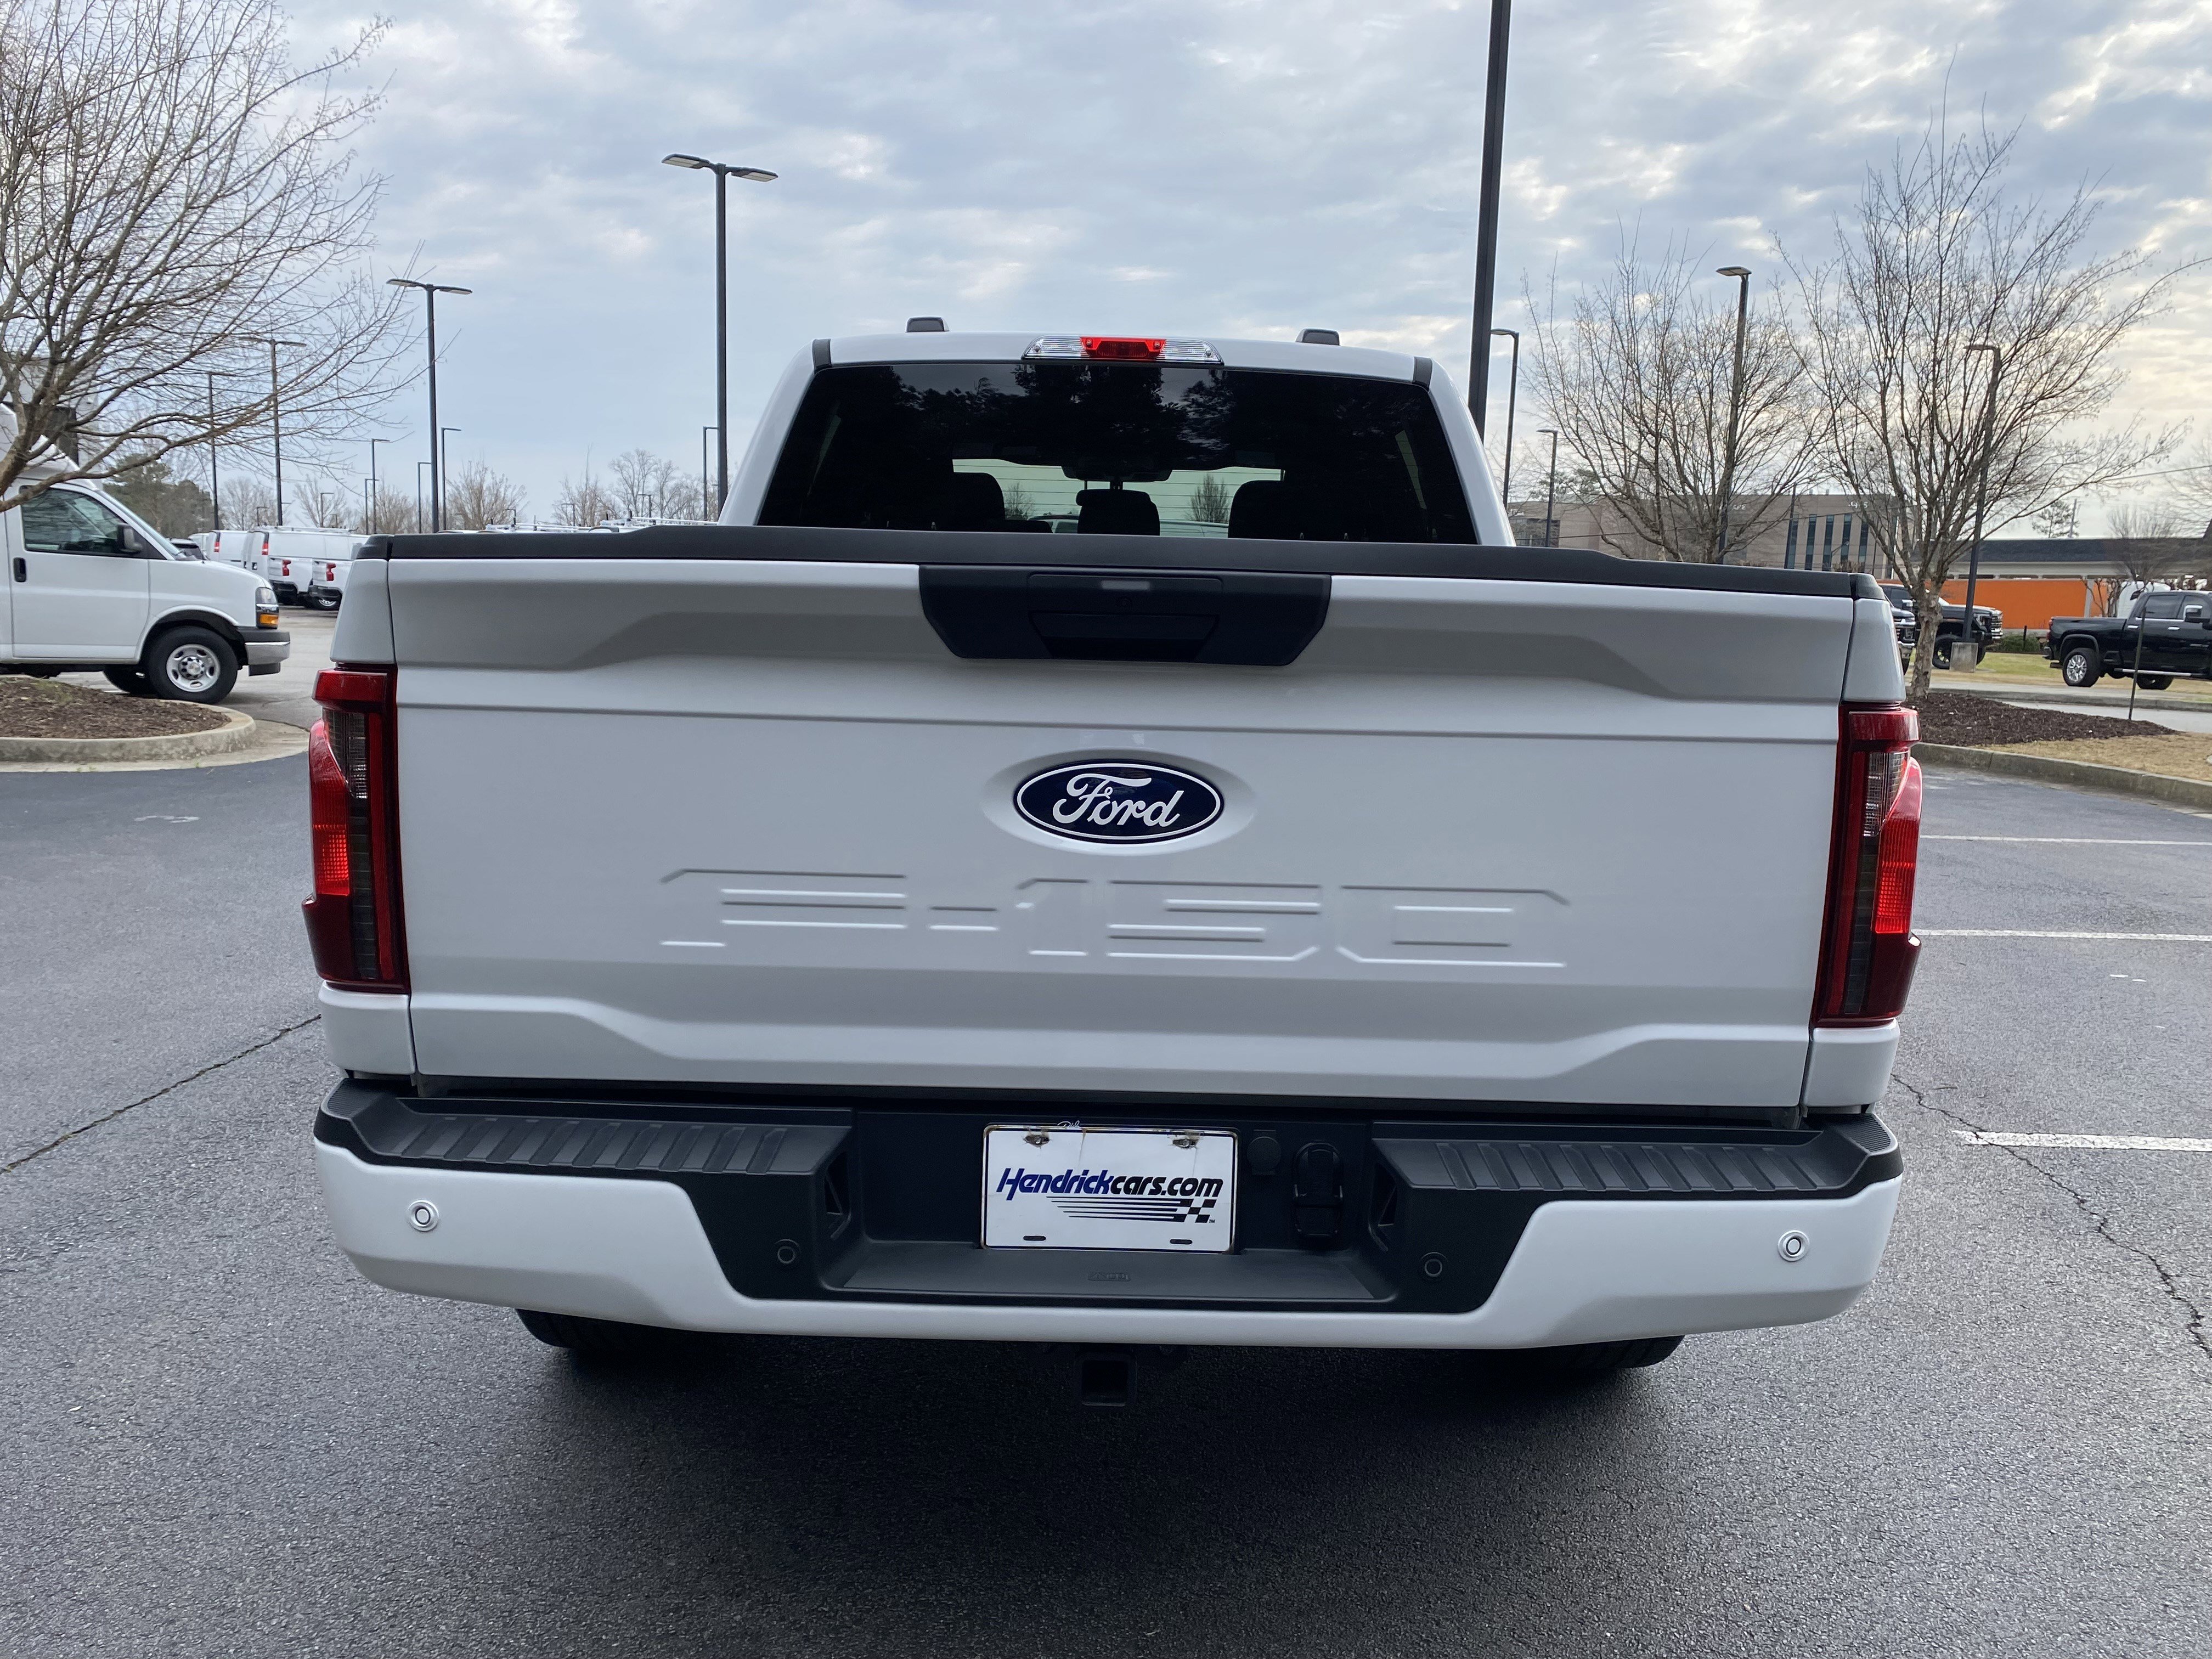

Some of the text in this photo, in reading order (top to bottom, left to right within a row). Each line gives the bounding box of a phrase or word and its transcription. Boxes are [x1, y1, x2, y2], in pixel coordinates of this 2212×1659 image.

[1052, 773, 1184, 827] Ford
[660, 868, 1570, 969] F-150
[996, 1167, 1224, 1201] Hendrickcars.com
